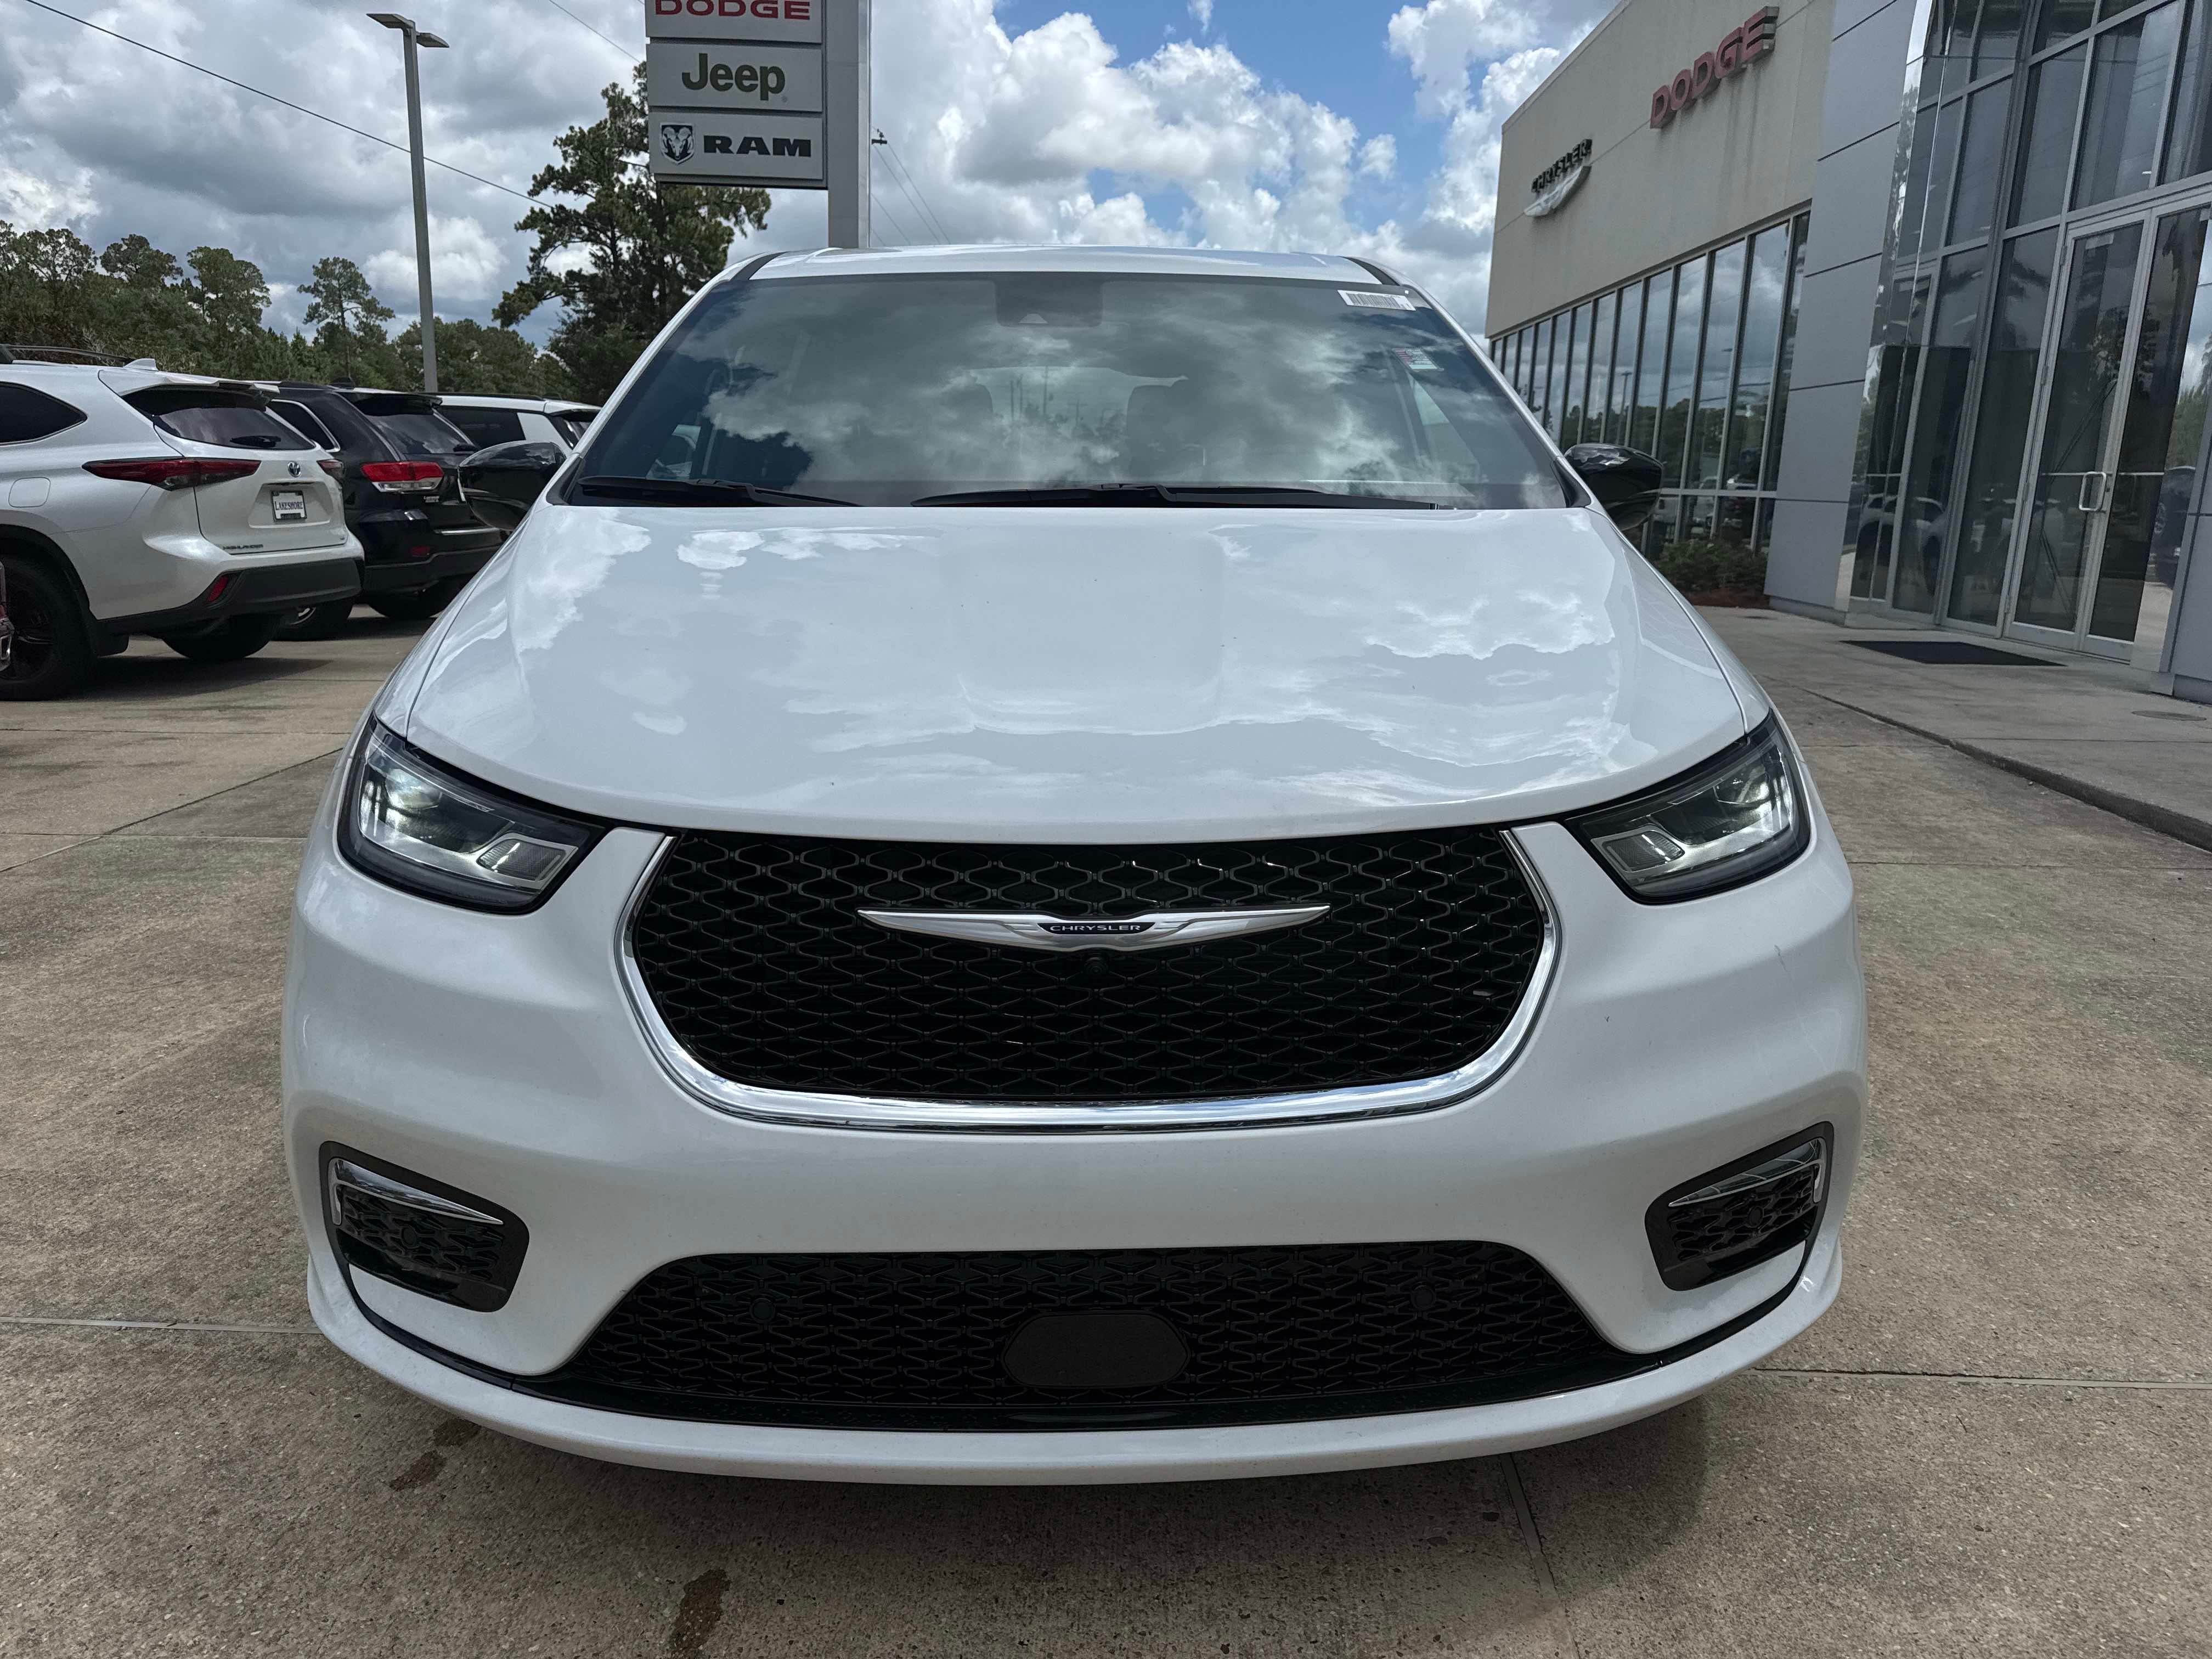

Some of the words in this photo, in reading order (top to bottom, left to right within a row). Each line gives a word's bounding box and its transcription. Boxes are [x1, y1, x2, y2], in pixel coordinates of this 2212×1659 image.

[656, 0, 810, 20] DODGE
[682, 53, 785, 100] Jeep
[1650, 6, 1779, 128] DODGE
[703, 135, 811, 157] RAM
